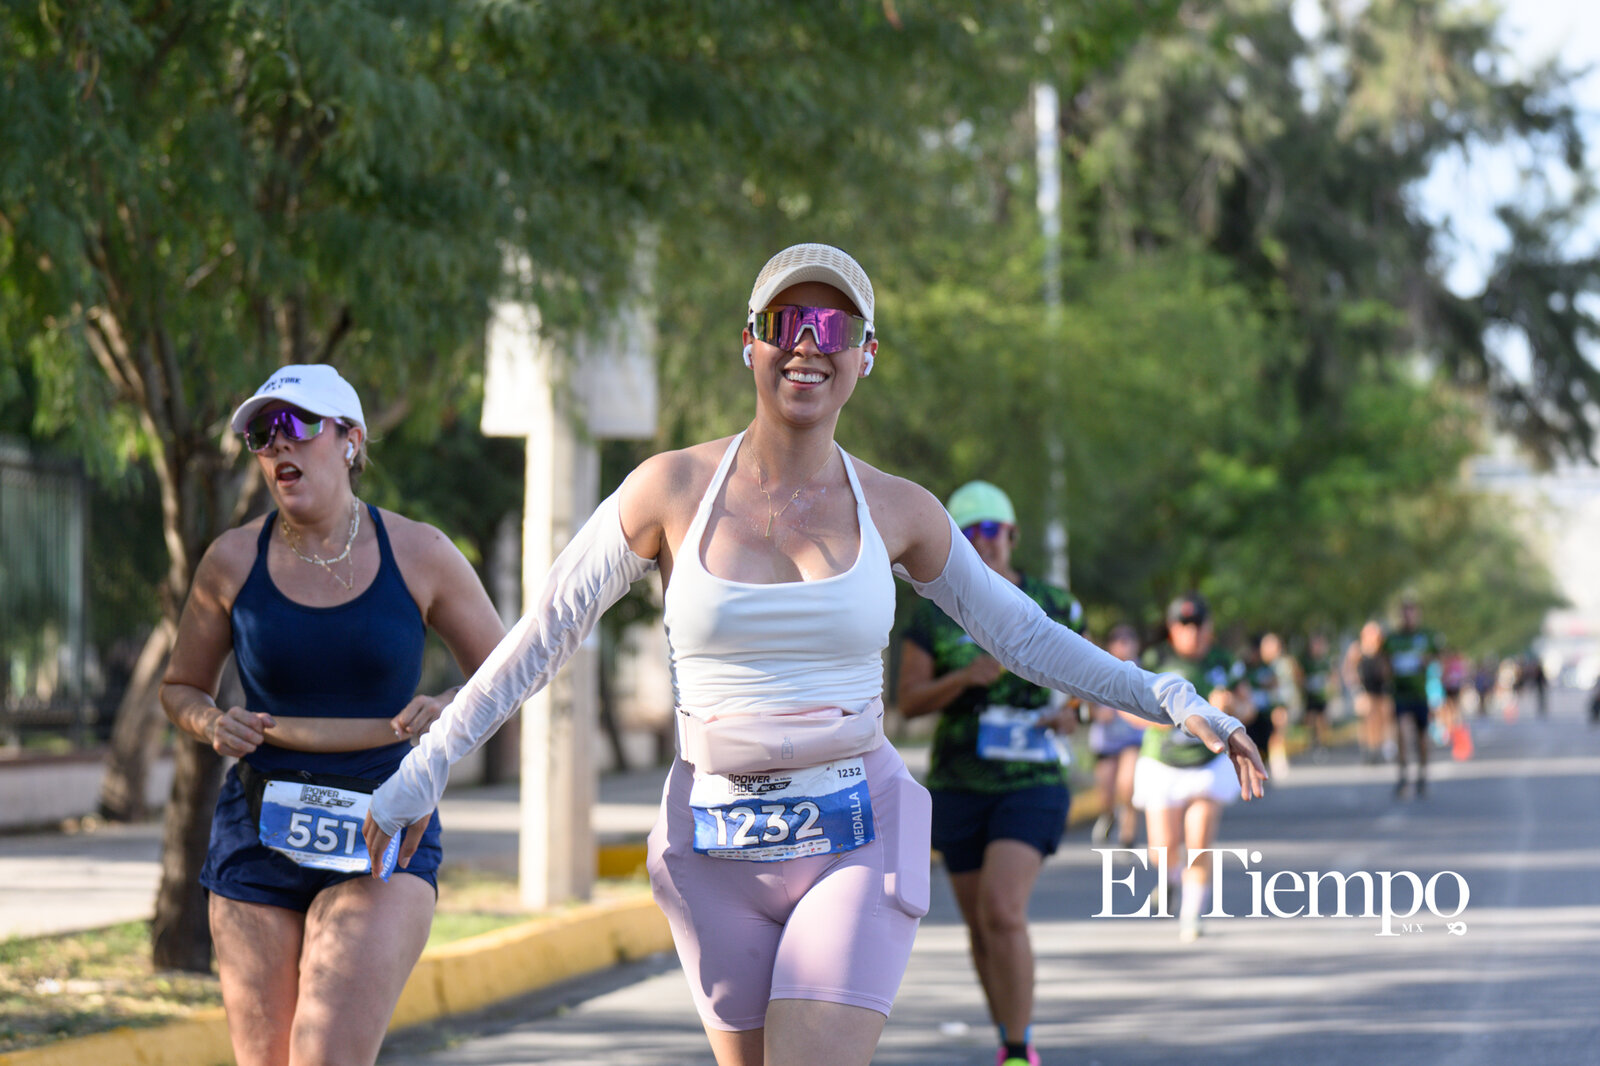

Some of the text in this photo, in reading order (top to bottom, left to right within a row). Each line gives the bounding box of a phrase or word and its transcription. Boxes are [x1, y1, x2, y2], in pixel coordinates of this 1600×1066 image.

[733, 775, 770, 783] POWER
[837, 767, 862, 778] 1232
[306, 786, 339, 798] POWER
[706, 801, 824, 846] 1232
[848, 791, 865, 846] MEDALLA
[286, 812, 358, 855] 551
